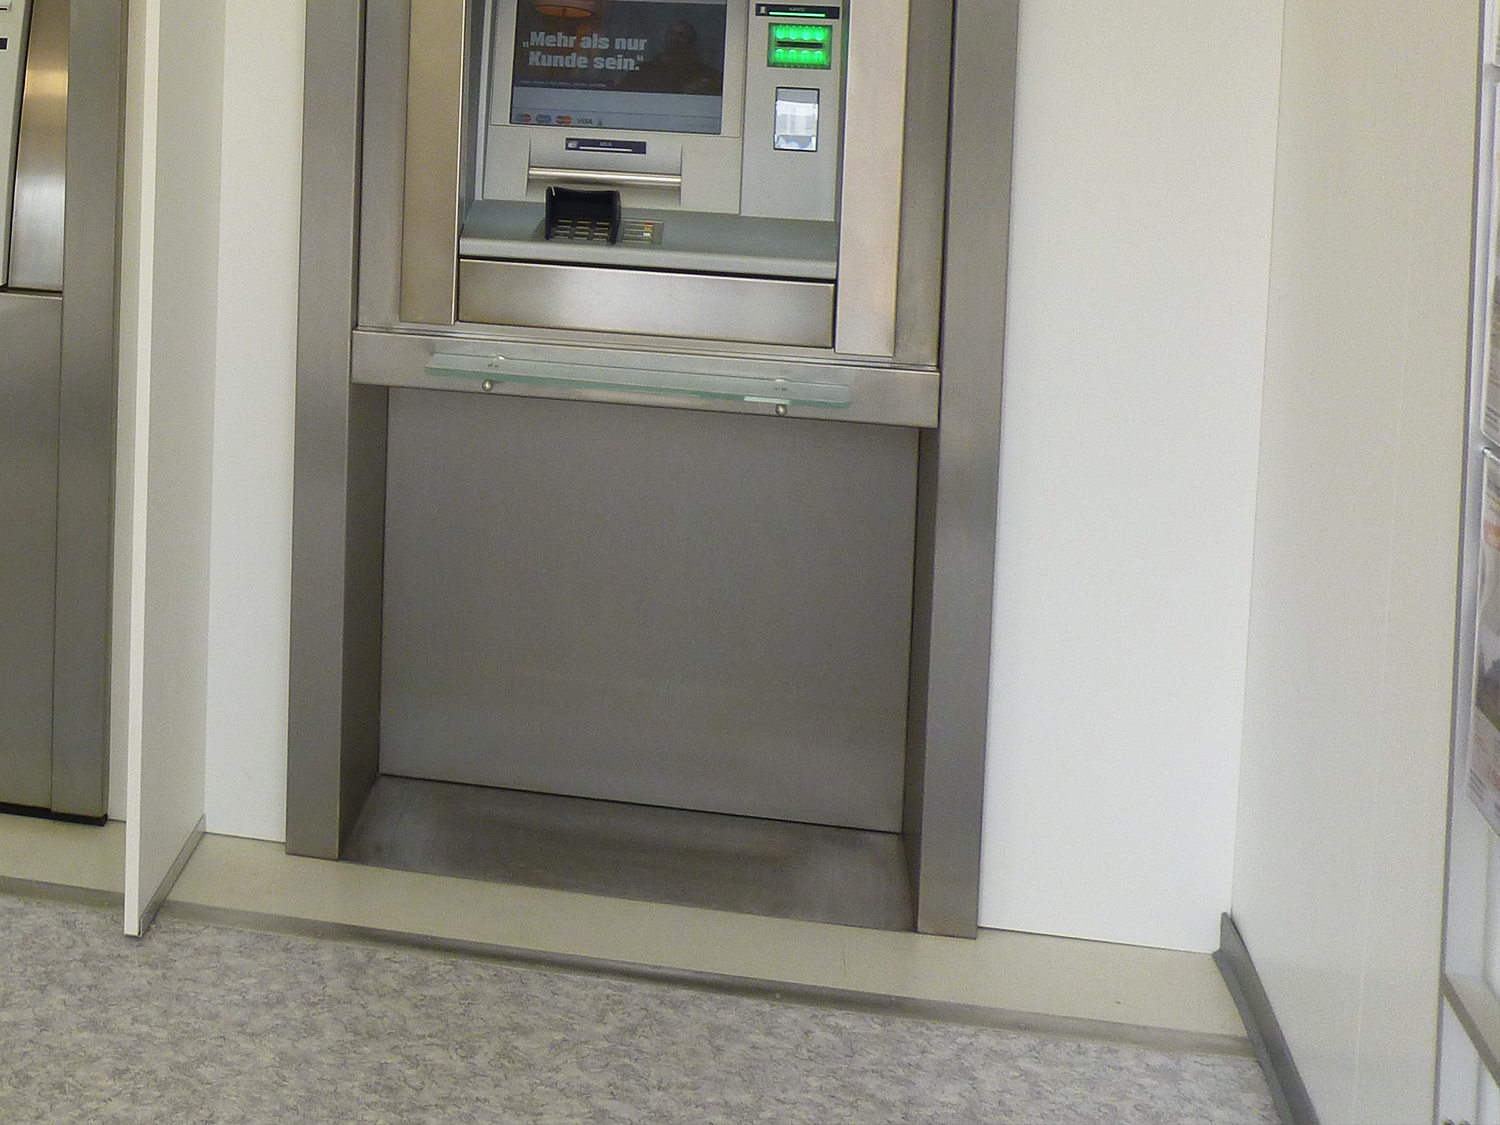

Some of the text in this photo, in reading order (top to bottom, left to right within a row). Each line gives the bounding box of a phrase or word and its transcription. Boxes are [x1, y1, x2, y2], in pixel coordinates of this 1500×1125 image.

[522, 31, 648, 51] „Mehr als nur
[528, 50, 589, 69] Kunde
